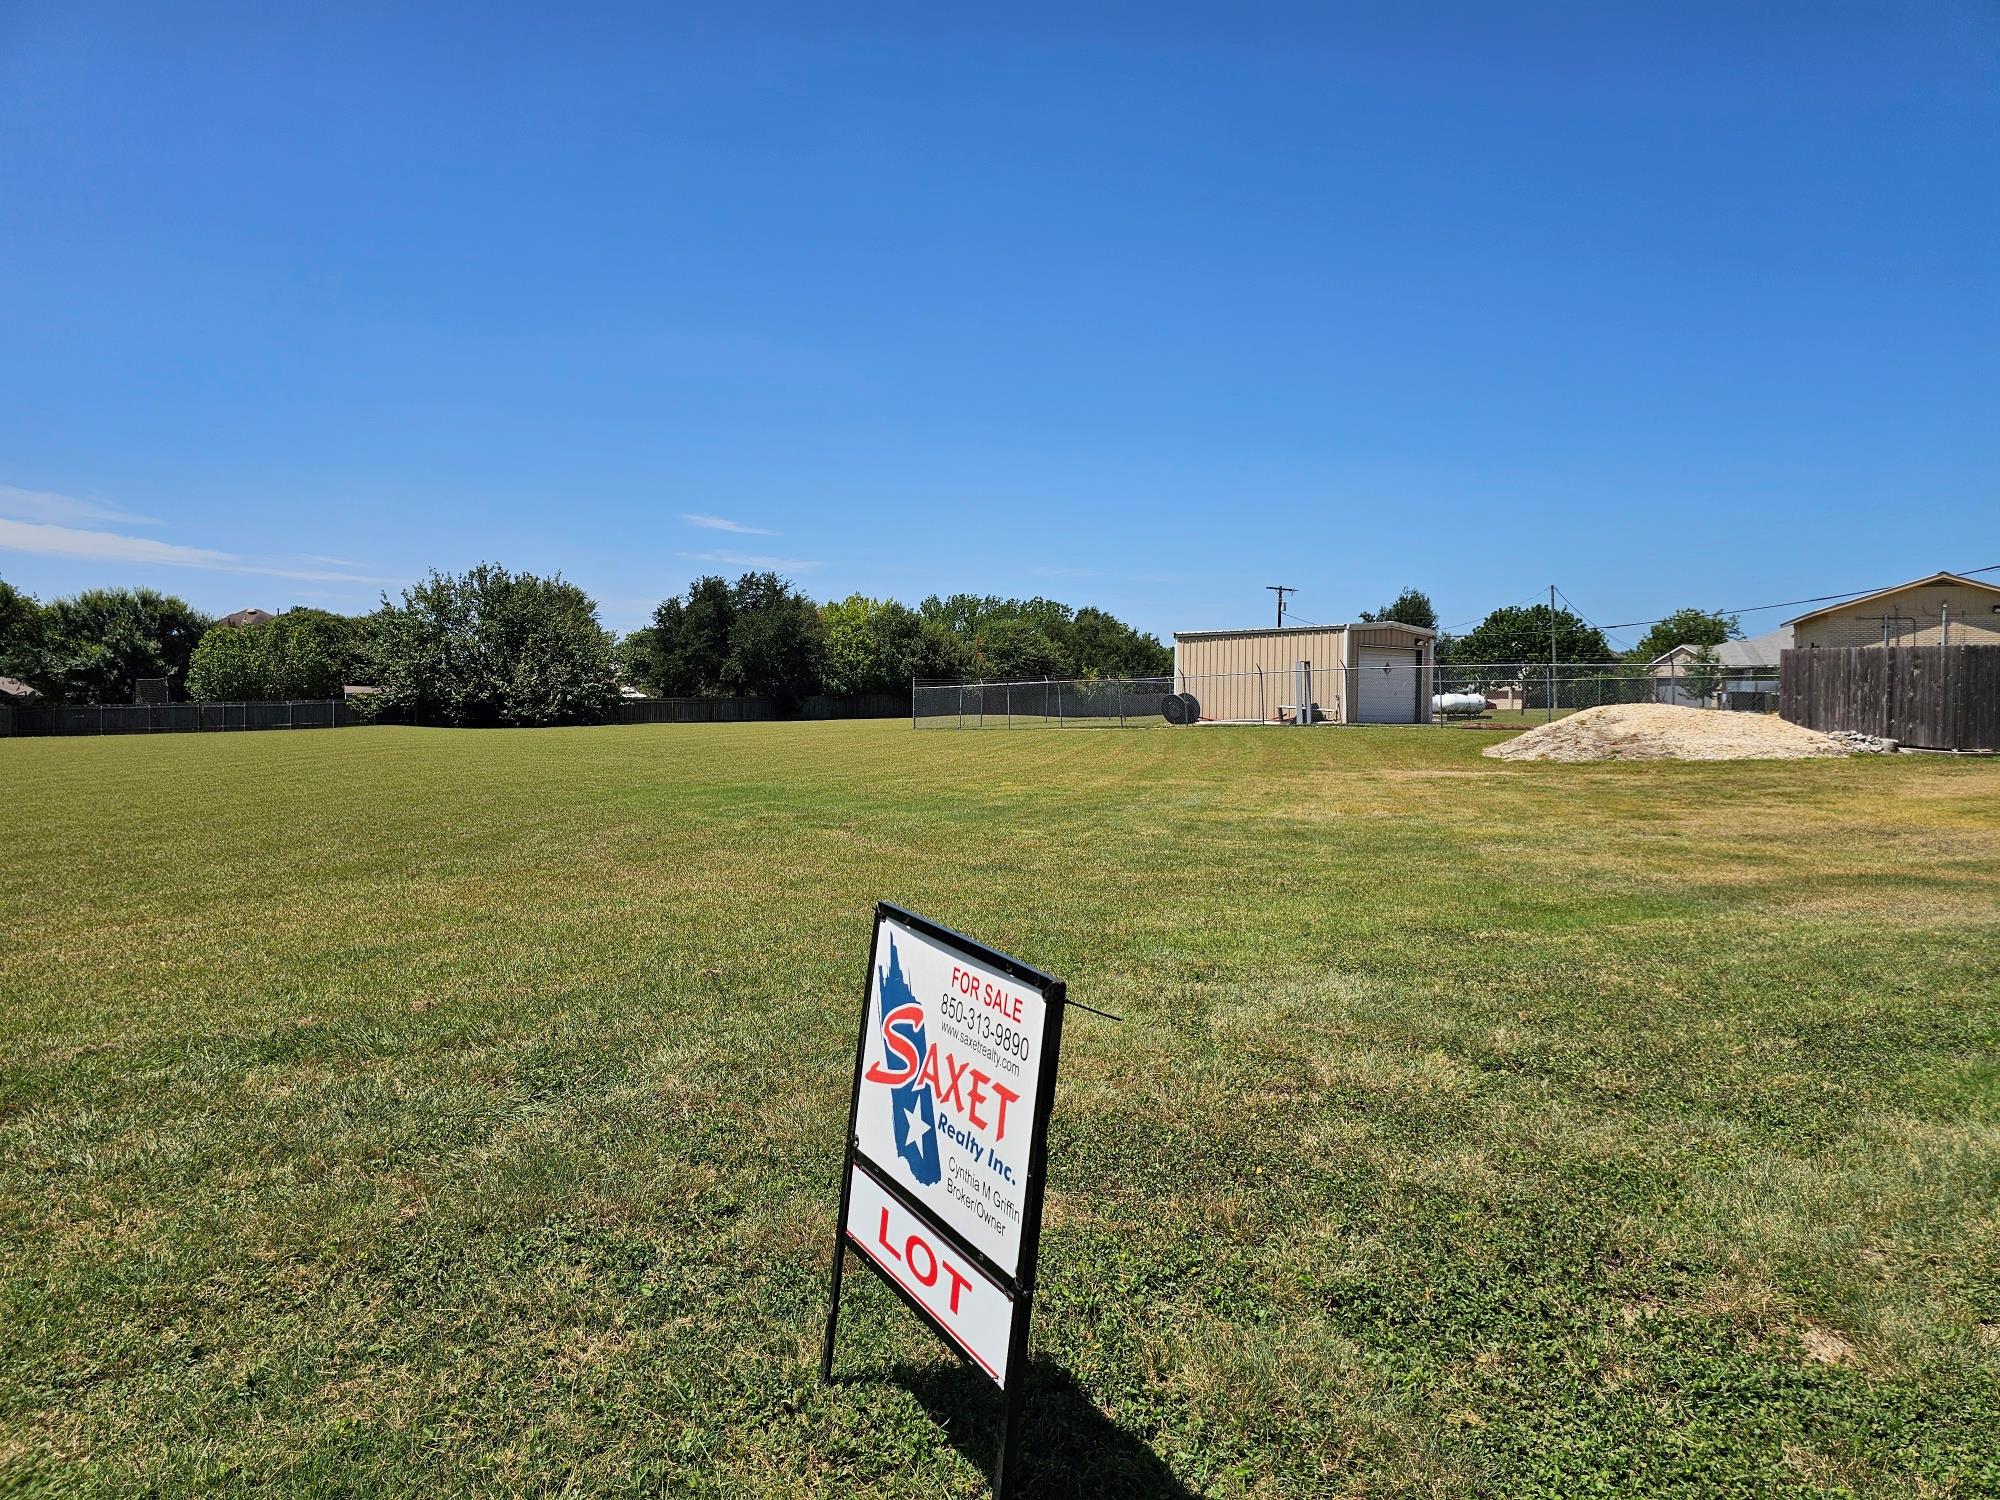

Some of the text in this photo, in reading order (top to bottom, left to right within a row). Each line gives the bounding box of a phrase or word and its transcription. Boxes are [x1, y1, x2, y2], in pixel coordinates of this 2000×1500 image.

[940, 993, 1030, 1062] 850-313-9890
[951, 966, 1024, 1024] FOR SALE
[865, 1005, 1021, 1142] SAXET
[940, 1020, 1020, 1077] www.saxetrealty.com
[937, 1112, 1016, 1186] Realty Inc.
[946, 1178, 1006, 1237] Broker/Owner
[948, 1156, 1020, 1225] Cynthia M Griffin
[878, 1206, 973, 1316] LOT
